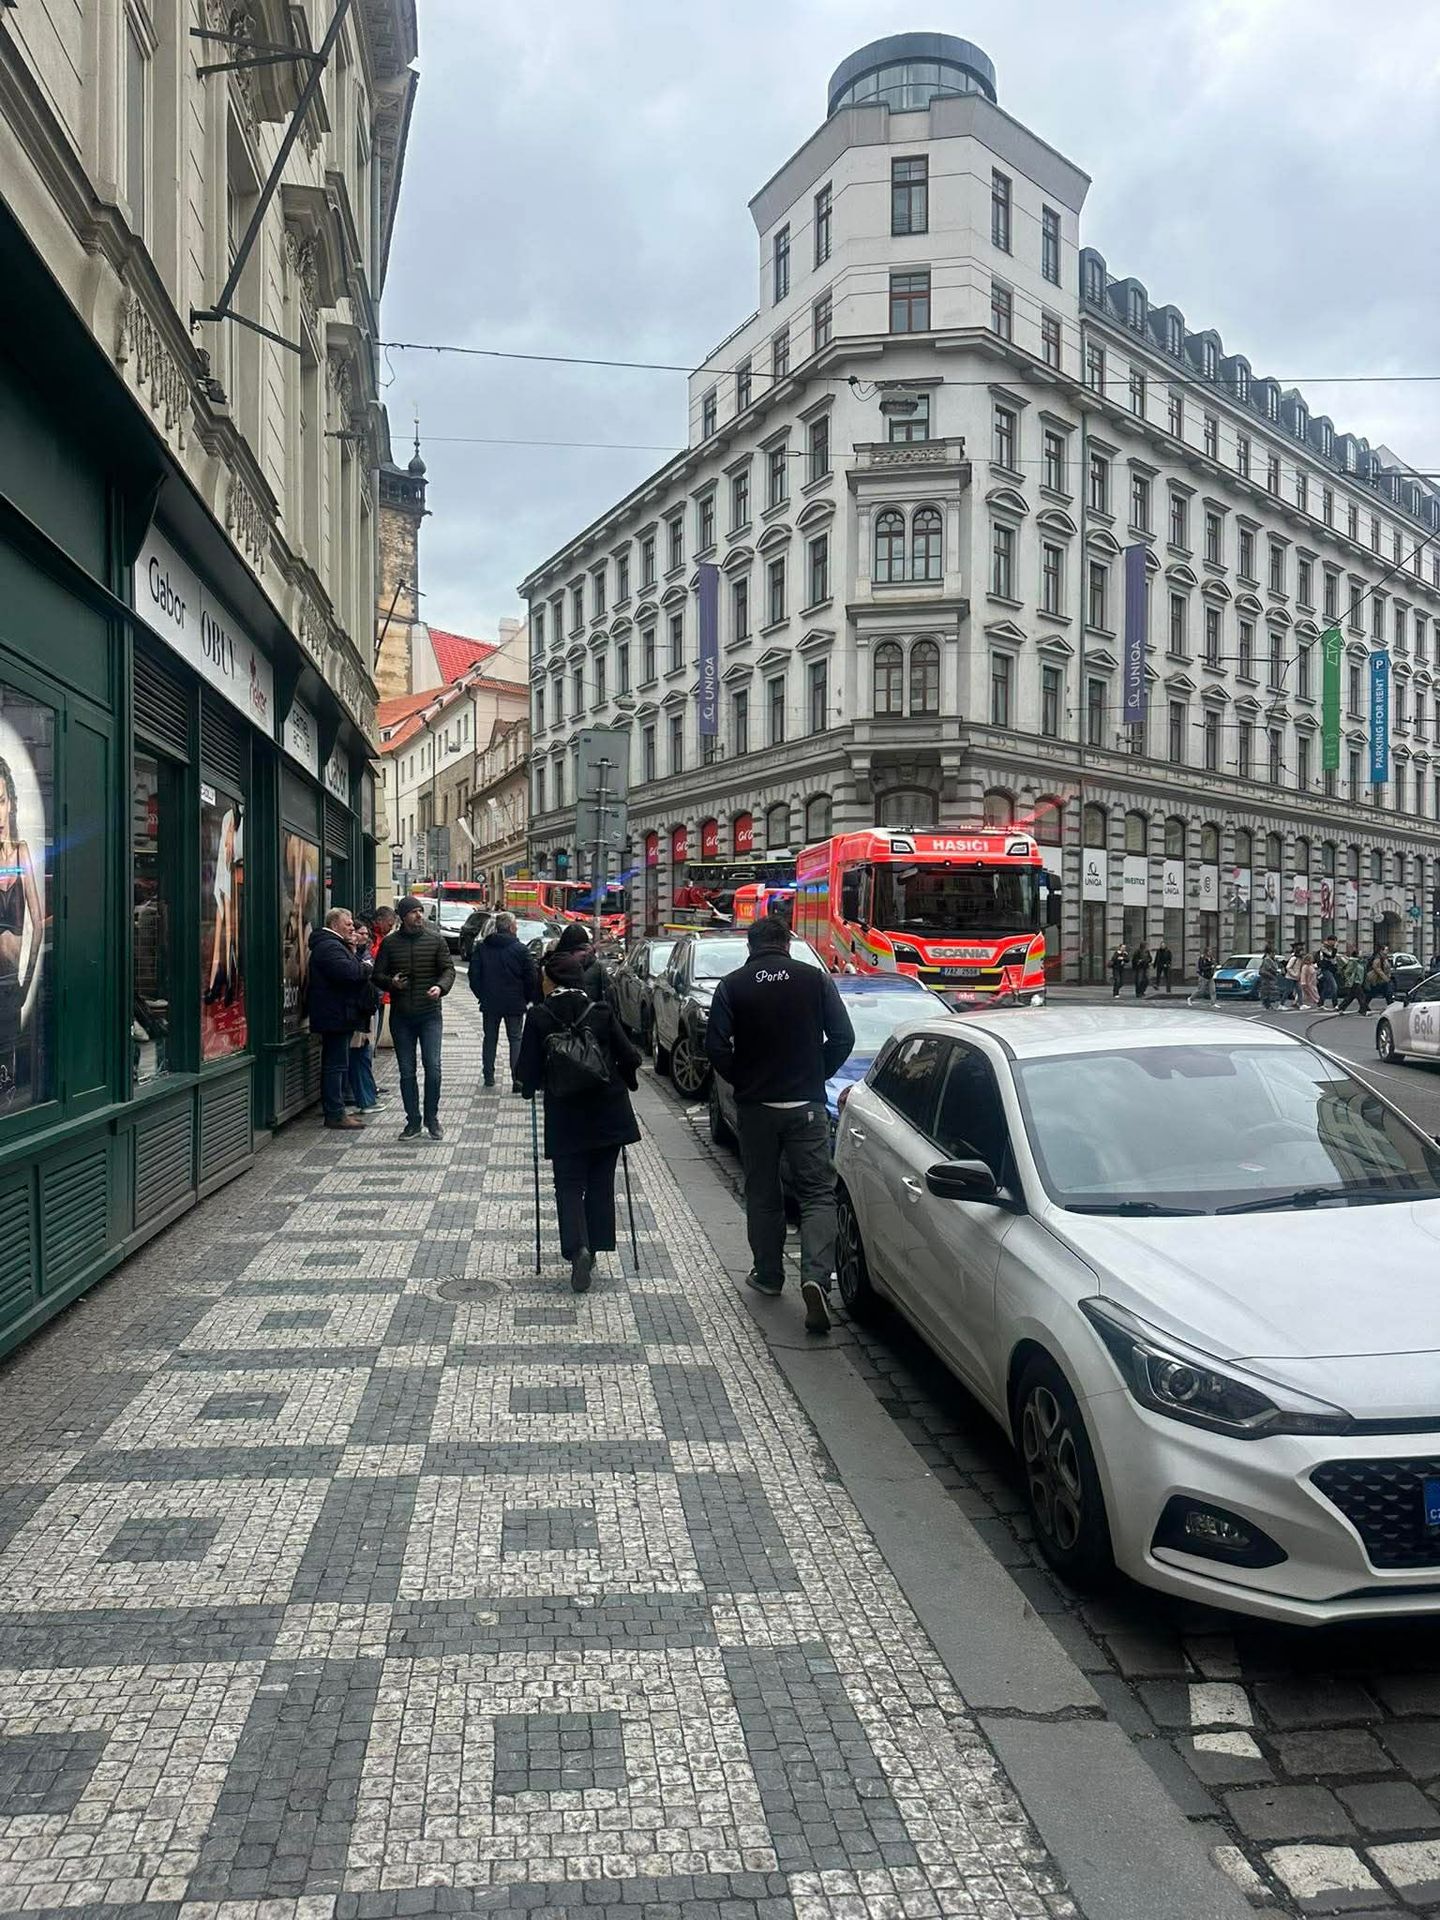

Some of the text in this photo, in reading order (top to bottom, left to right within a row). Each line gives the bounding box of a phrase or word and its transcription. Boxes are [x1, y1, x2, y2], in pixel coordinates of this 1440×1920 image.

[149, 556, 187, 629] Gabor
[1130, 640, 1141, 687] UNIQA
[1376, 659, 1384, 669] P
[704, 656, 715, 700] UNIQA
[1375, 678, 1384, 769] PARKING FOR RENT
[932, 839, 989, 851] HASIČI
[1084, 878, 1102, 887] UNIQA
[1164, 887, 1179, 895] UNIQA
[931, 947, 990, 958] SCANIA
[871, 953, 879, 966] 3
[755, 969, 790, 983] Pork's
[1414, 1014, 1433, 1036] Bolt
